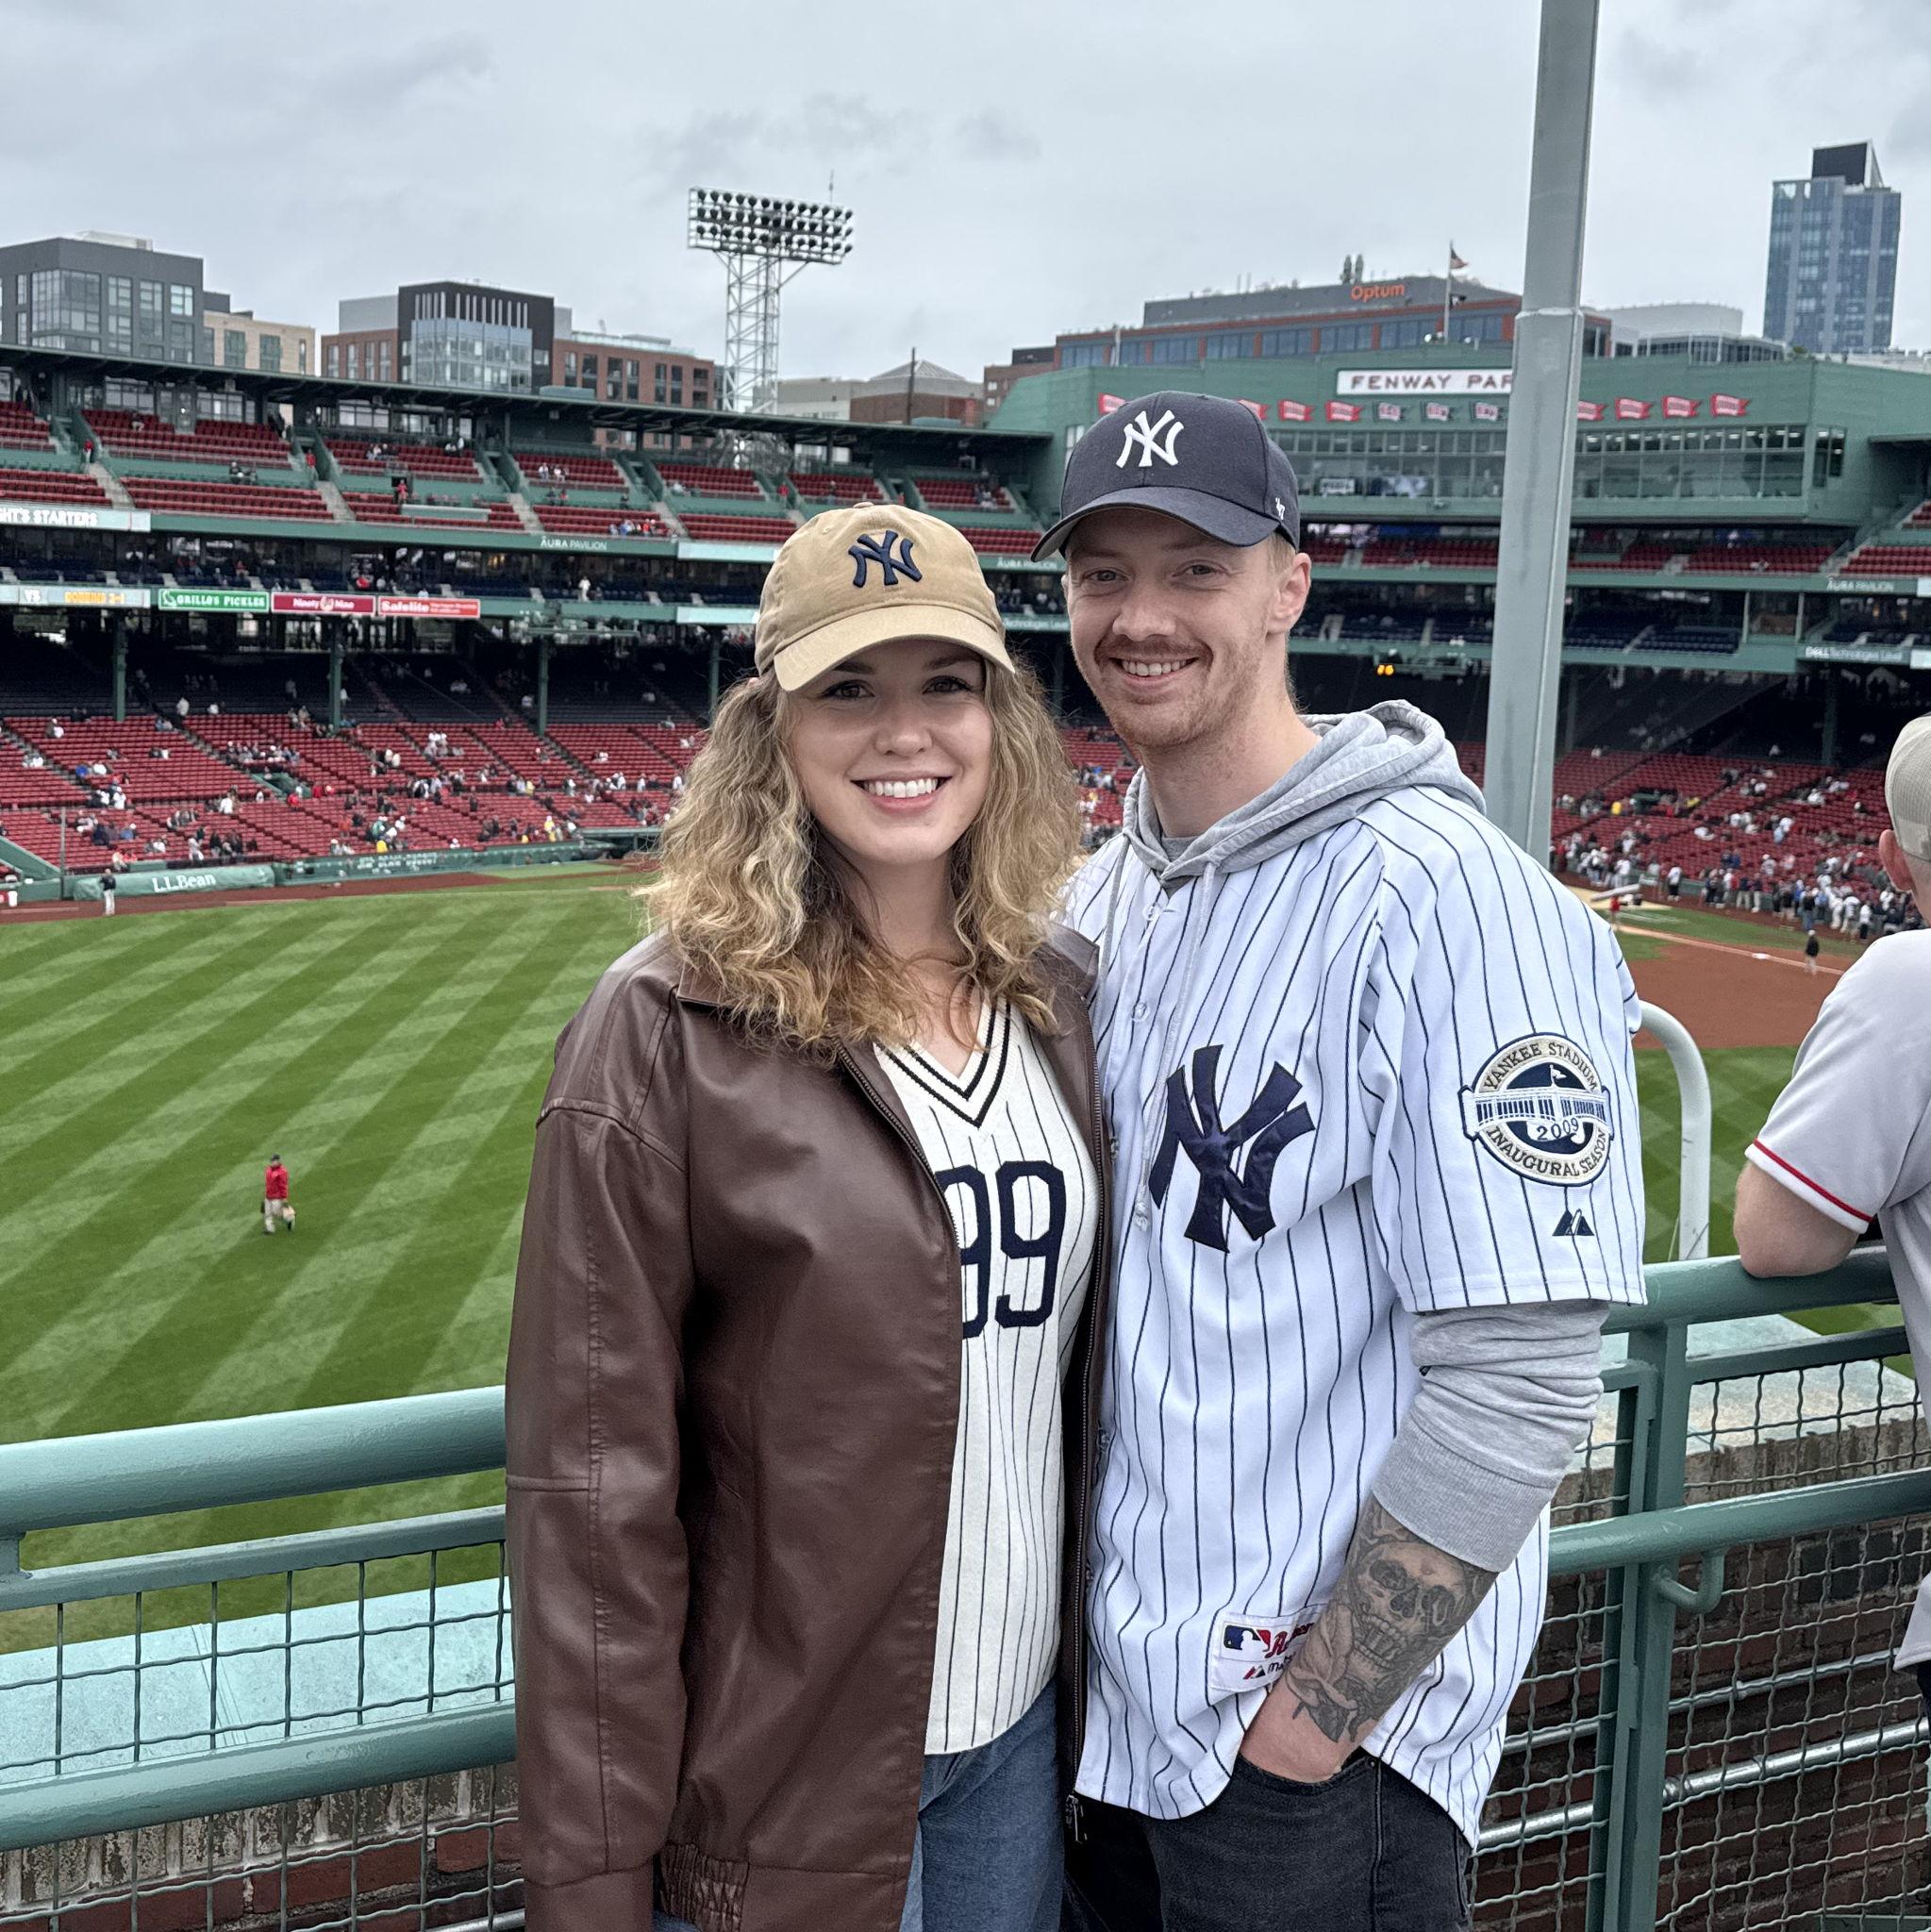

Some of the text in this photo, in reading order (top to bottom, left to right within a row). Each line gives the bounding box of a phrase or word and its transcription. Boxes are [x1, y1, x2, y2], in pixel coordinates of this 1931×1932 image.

[1351, 284, 1405, 303] Optum
[1351, 375, 1451, 390] FENWAY
[1116, 409, 1185, 468] NY
[0, 507, 98, 526] HT'S STARTERS
[570, 540, 608, 551] PAVILION
[848, 530, 923, 588] NY
[176, 594, 265, 607] GRILLO'S PICKLES
[382, 600, 429, 612] Safelite
[1485, 1041, 1598, 1091] YANKEE STADIUM
[1537, 1118, 1579, 1141] 2009
[1148, 1043, 1315, 1253] NY
[1487, 1125, 1606, 1176] INAUGURAL SEASON
